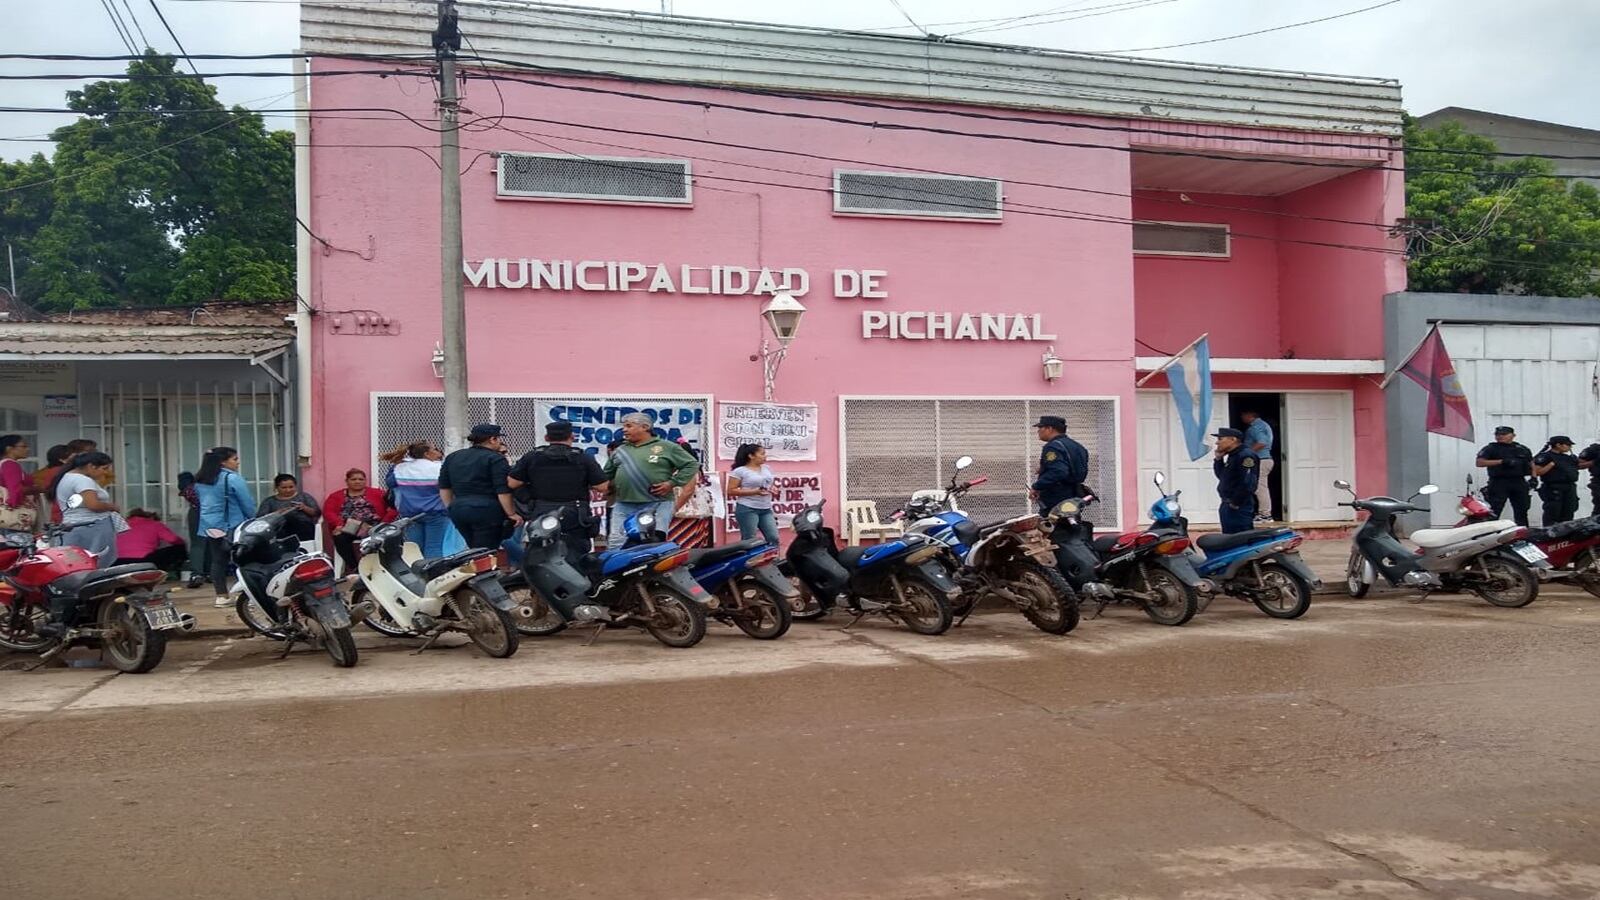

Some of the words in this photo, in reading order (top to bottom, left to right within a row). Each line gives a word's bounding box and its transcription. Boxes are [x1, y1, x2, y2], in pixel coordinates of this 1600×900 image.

[463, 258, 810, 297] MUNICIPALIDAD
[834, 269, 889, 298] DE
[863, 311, 1057, 340] PICHANAL
[679, 408, 703, 425] DE
[648, 455, 659, 463] 2
[785, 490, 804, 501] DE
